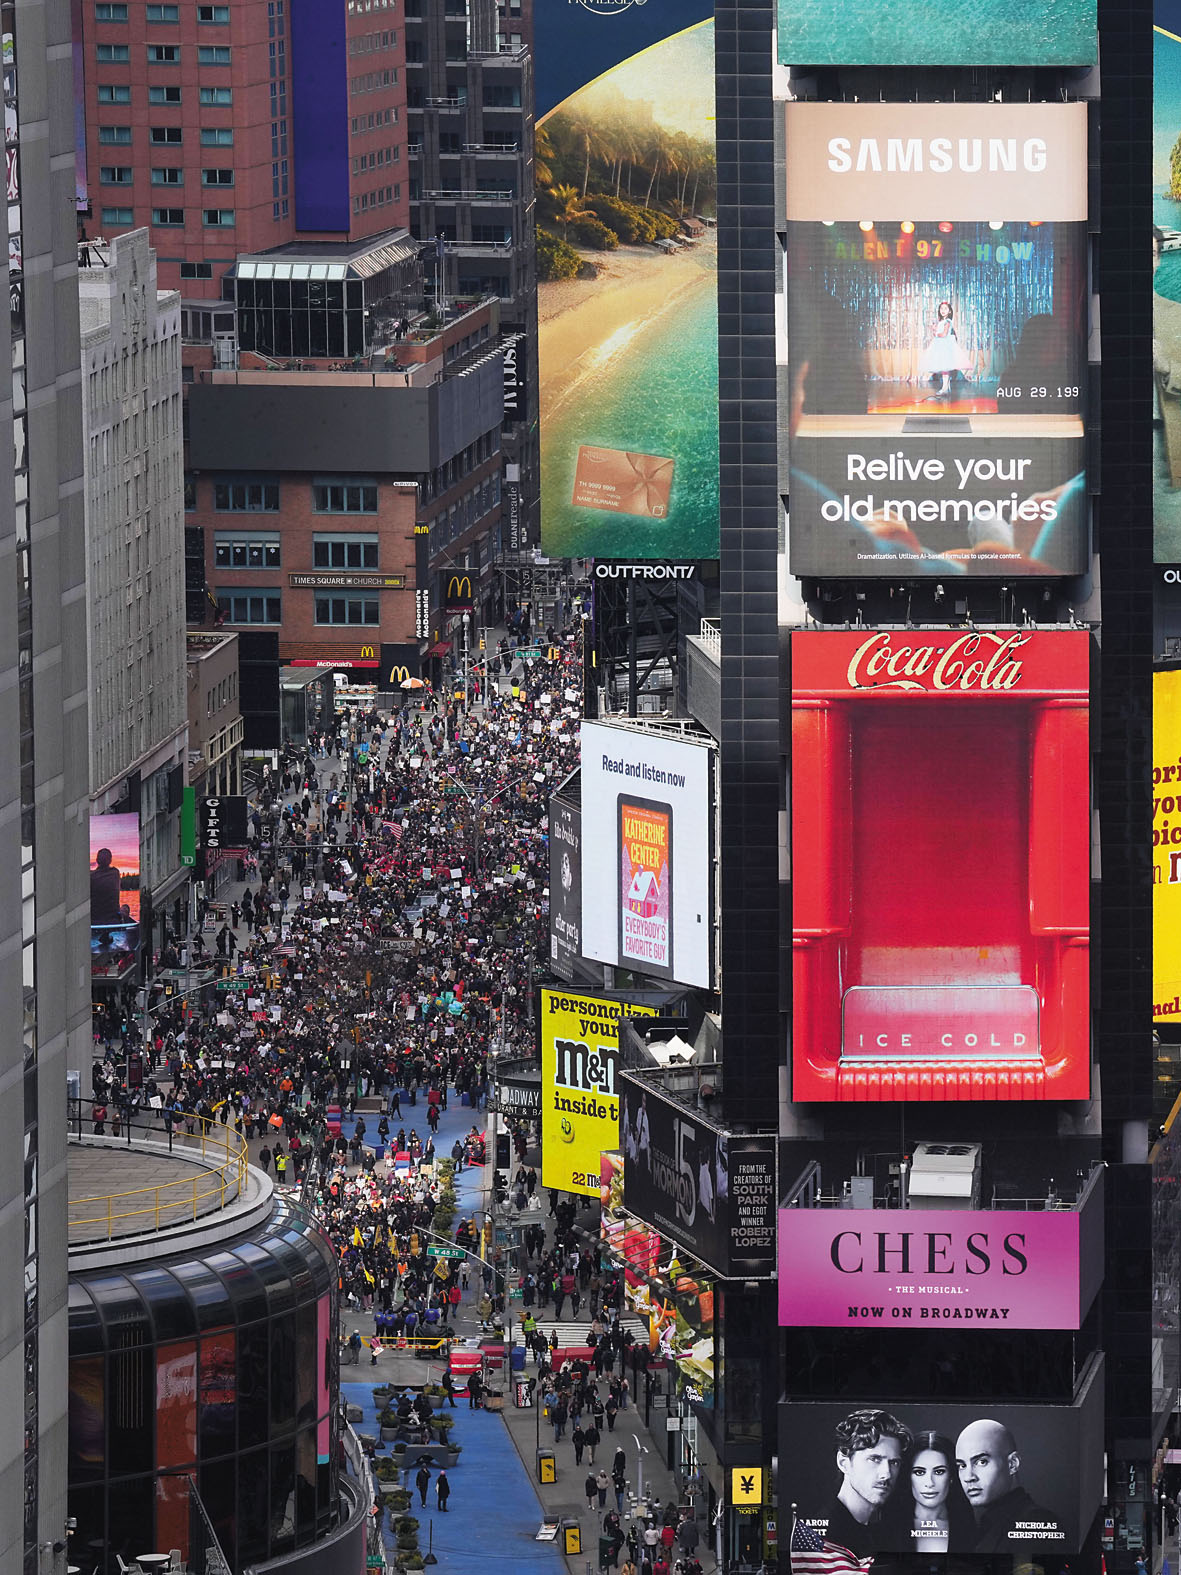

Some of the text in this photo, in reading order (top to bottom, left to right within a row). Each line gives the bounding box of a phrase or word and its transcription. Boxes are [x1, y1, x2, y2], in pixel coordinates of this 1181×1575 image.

[827, 137, 1048, 173] SAMSUNG
[827, 239, 1033, 265] TALENT 97 SHOW
[996, 386, 1022, 398] AUG
[847, 451, 1032, 490] Relive your
[821, 492, 1058, 522] old memories
[978, 553, 998, 562] upscale
[294, 577, 316, 585] TIMES
[317, 577, 345, 585] SQUARE
[602, 754, 686, 788] Read and listen now
[206, 799, 219, 847] GIFTS
[624, 817, 666, 846] KATHERINE
[182, 856, 193, 864] TD
[631, 842, 660, 868] CENTER
[566, 921, 578, 945] party
[625, 916, 666, 942] EVERYBODY'S
[625, 941, 666, 961] FAVORITE GUY
[579, 1018, 619, 1038] your
[859, 1031, 1027, 1047] ICE COLD
[554, 1091, 607, 1119] inside
[739, 1165, 766, 1174] FROM THE
[572, 1172, 586, 1187] 22
[653, 1160, 693, 1210] MORMON
[733, 1175, 772, 1185] CREATORS OF
[733, 1185, 773, 1195] SOUTH
[737, 1195, 769, 1205] PARK
[738, 1206, 767, 1215] AND EGOT
[741, 1217, 764, 1226] WINNER
[731, 1227, 776, 1236] ROBERT
[735, 1237, 772, 1247] LOPEZ
[830, 1231, 1028, 1275] CHESS
[895, 1286, 964, 1294] THE MUSICAL
[847, 1306, 1010, 1320] NOW ON BROADWAY
[740, 1475, 755, 1494] ¥
[920, 1520, 938, 1528] LEA
[1015, 1521, 1058, 1530] NICHOLAS
[910, 1530, 948, 1538] MICHELE
[1007, 1530, 1065, 1539] CHRISTOPHER
